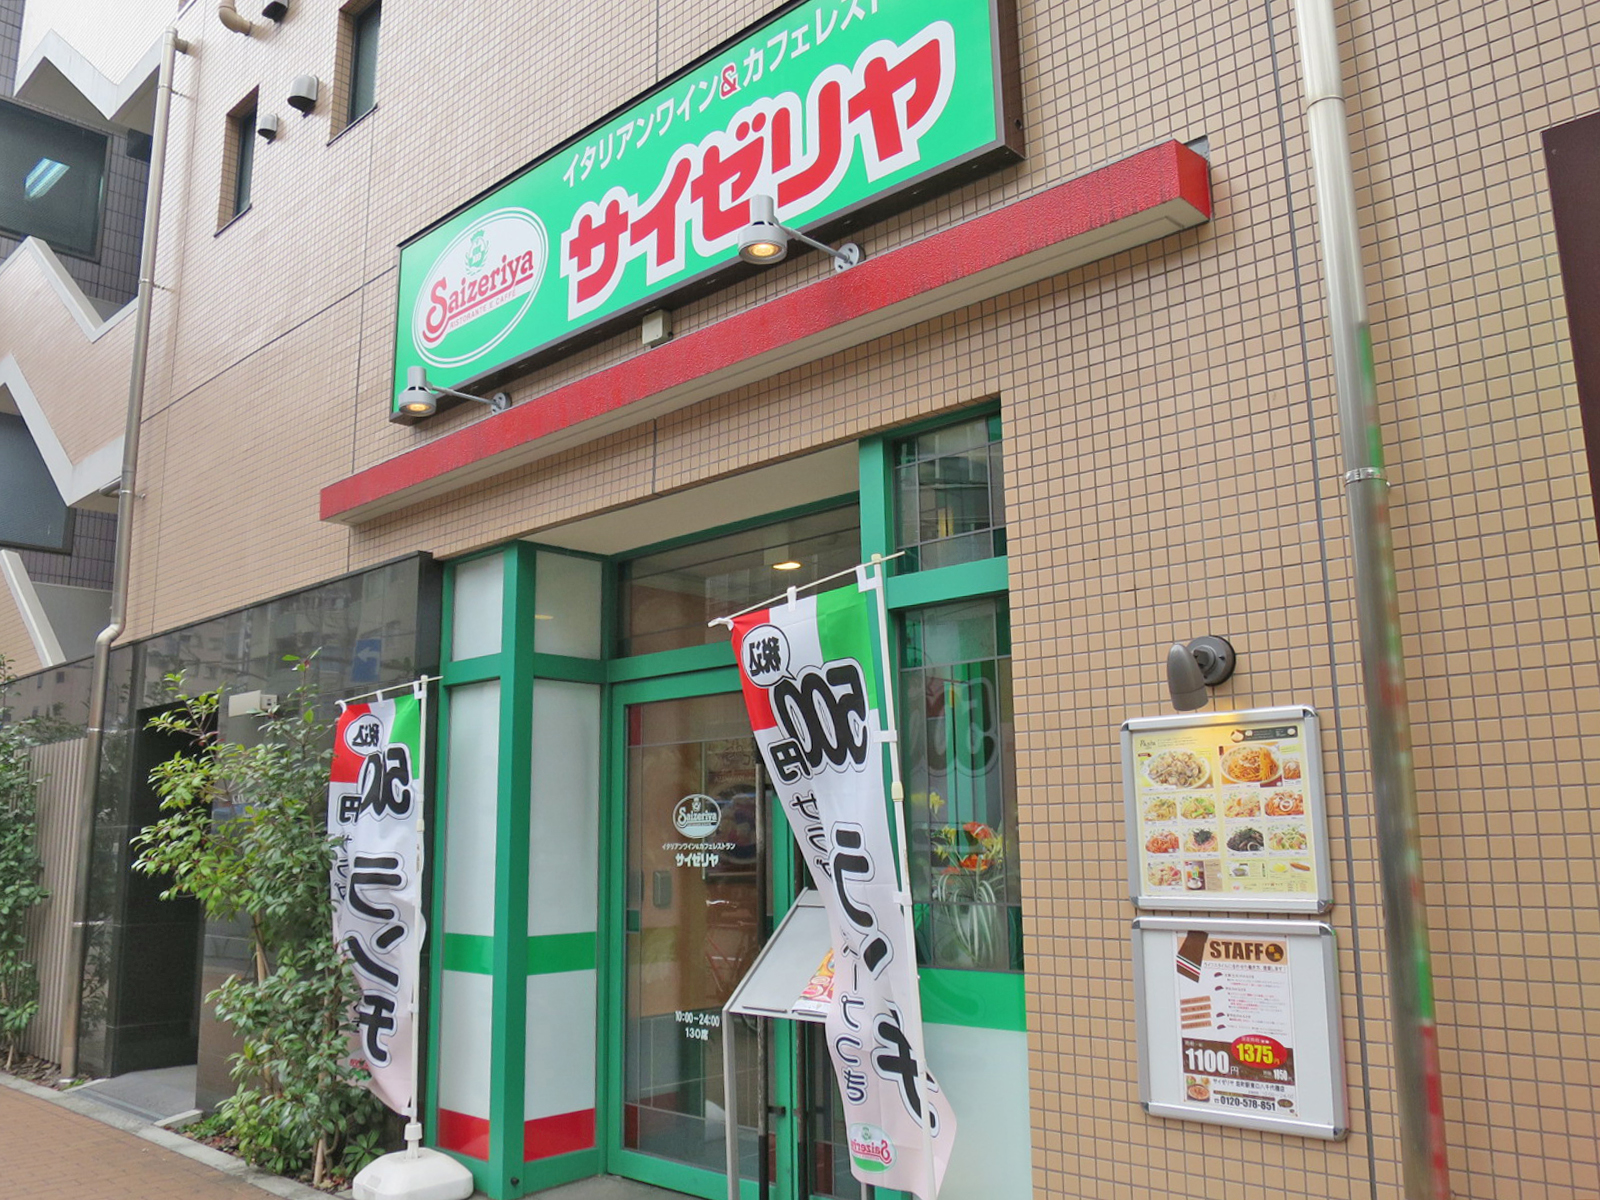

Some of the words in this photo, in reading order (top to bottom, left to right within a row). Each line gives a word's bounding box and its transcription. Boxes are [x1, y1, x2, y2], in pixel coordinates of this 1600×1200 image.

[562, 24, 953, 317] サイゼリヤ
[422, 250, 535, 343] Saizeriya
[449, 305, 487, 329] RISTORANTE
[677, 806, 718, 828] Saizeriya
[675, 852, 719, 868] サイゼリヤ
[1209, 940, 1264, 962] STAFF
